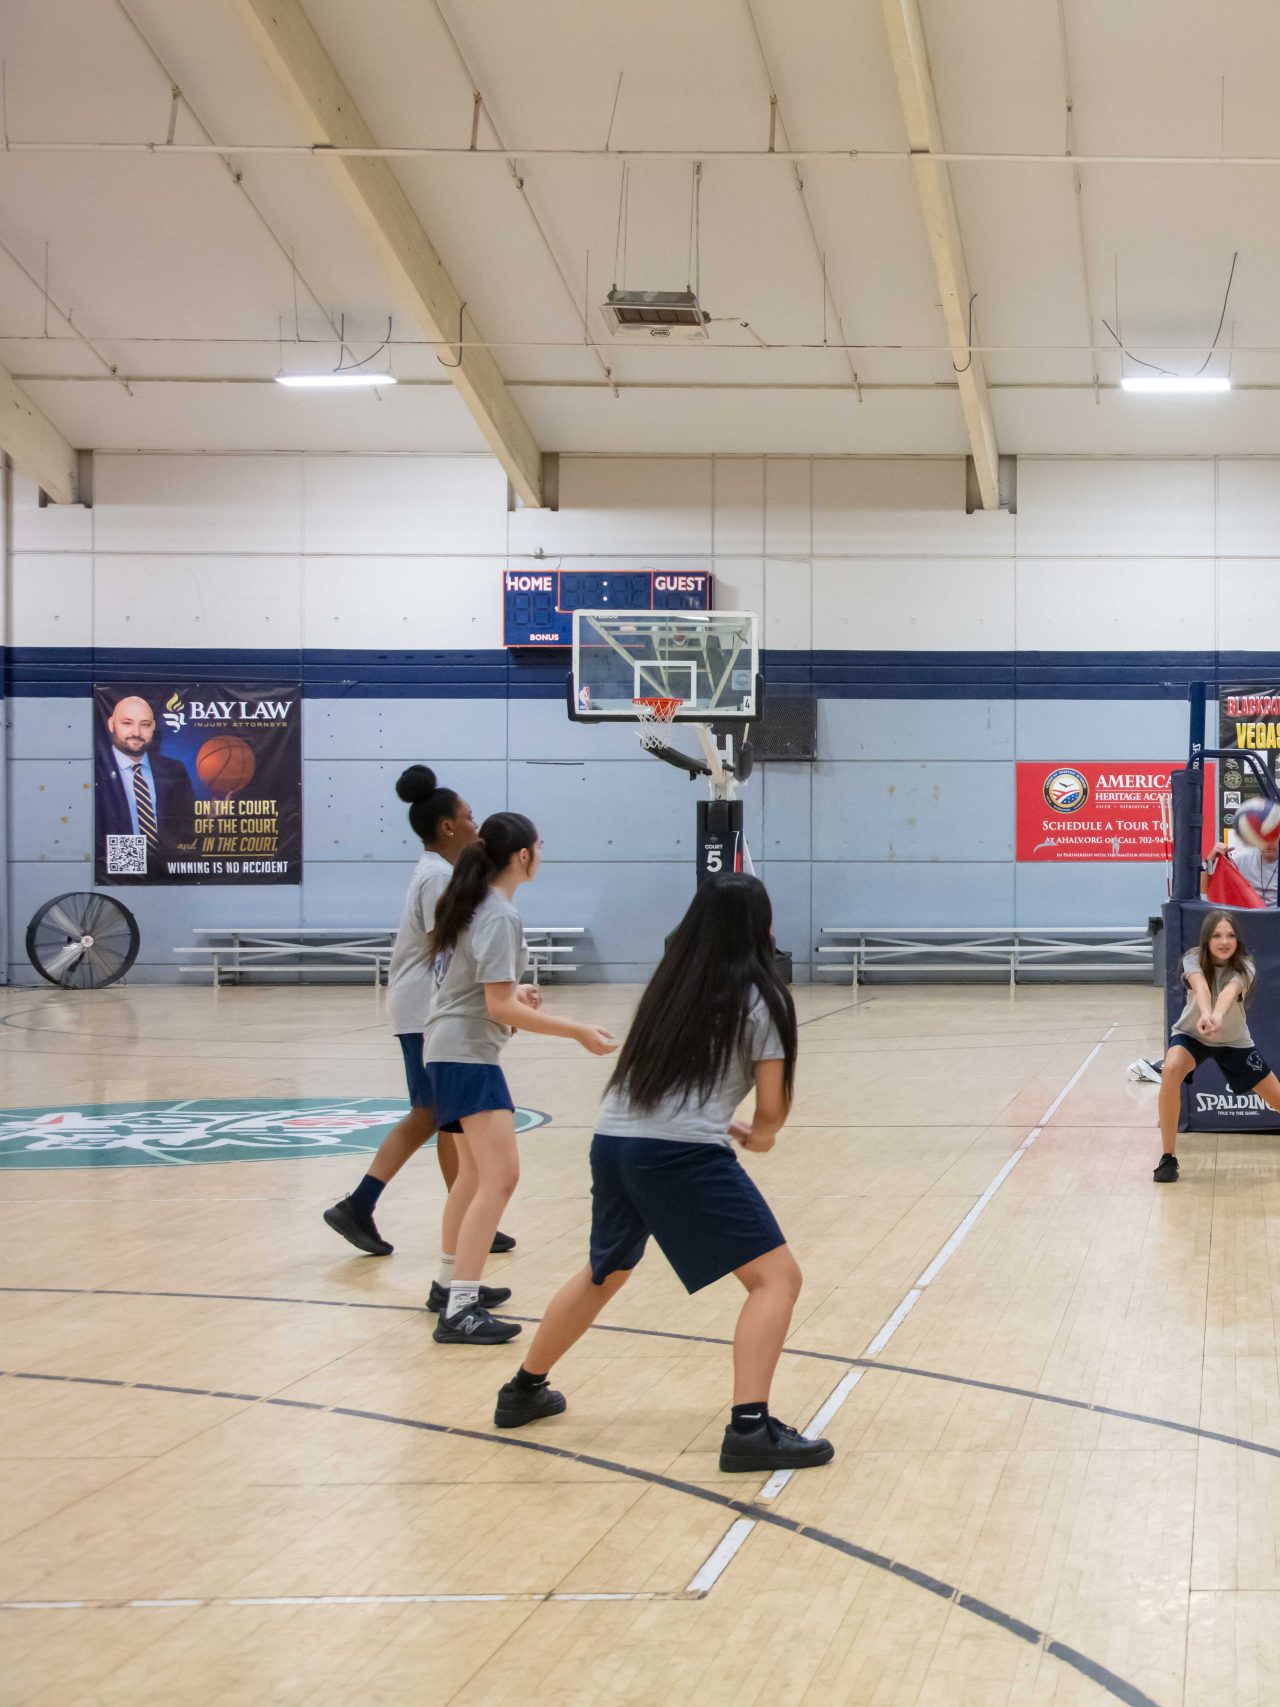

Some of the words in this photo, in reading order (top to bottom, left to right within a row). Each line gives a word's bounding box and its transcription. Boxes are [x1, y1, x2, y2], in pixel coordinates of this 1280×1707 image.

[507, 577, 552, 592] HOME
[655, 576, 705, 591] GUEST
[529, 633, 559, 641] BONUS
[189, 701, 239, 720] BAY
[240, 701, 293, 720] LAW
[744, 698, 750, 709] 4
[1095, 792, 1142, 801] HERITAGE
[194, 801, 210, 816] ON
[215, 801, 236, 816] THE
[238, 800, 279, 818] COURT,
[194, 819, 215, 834] OFF
[217, 819, 237, 834] THE
[240, 819, 279, 836] COURT,
[1042, 820, 1102, 831] SCHEDULE
[1104, 821, 1113, 831] A
[1115, 820, 1149, 831] TOUR
[202, 837, 214, 852] IN
[217, 837, 237, 852] THE
[239, 837, 279, 852] COURT.
[167, 862, 210, 874] WINNING
[213, 862, 223, 873] IS
[226, 862, 240, 873] NO
[242, 861, 289, 873] ACCIDENT
[706, 851, 722, 872] 5
